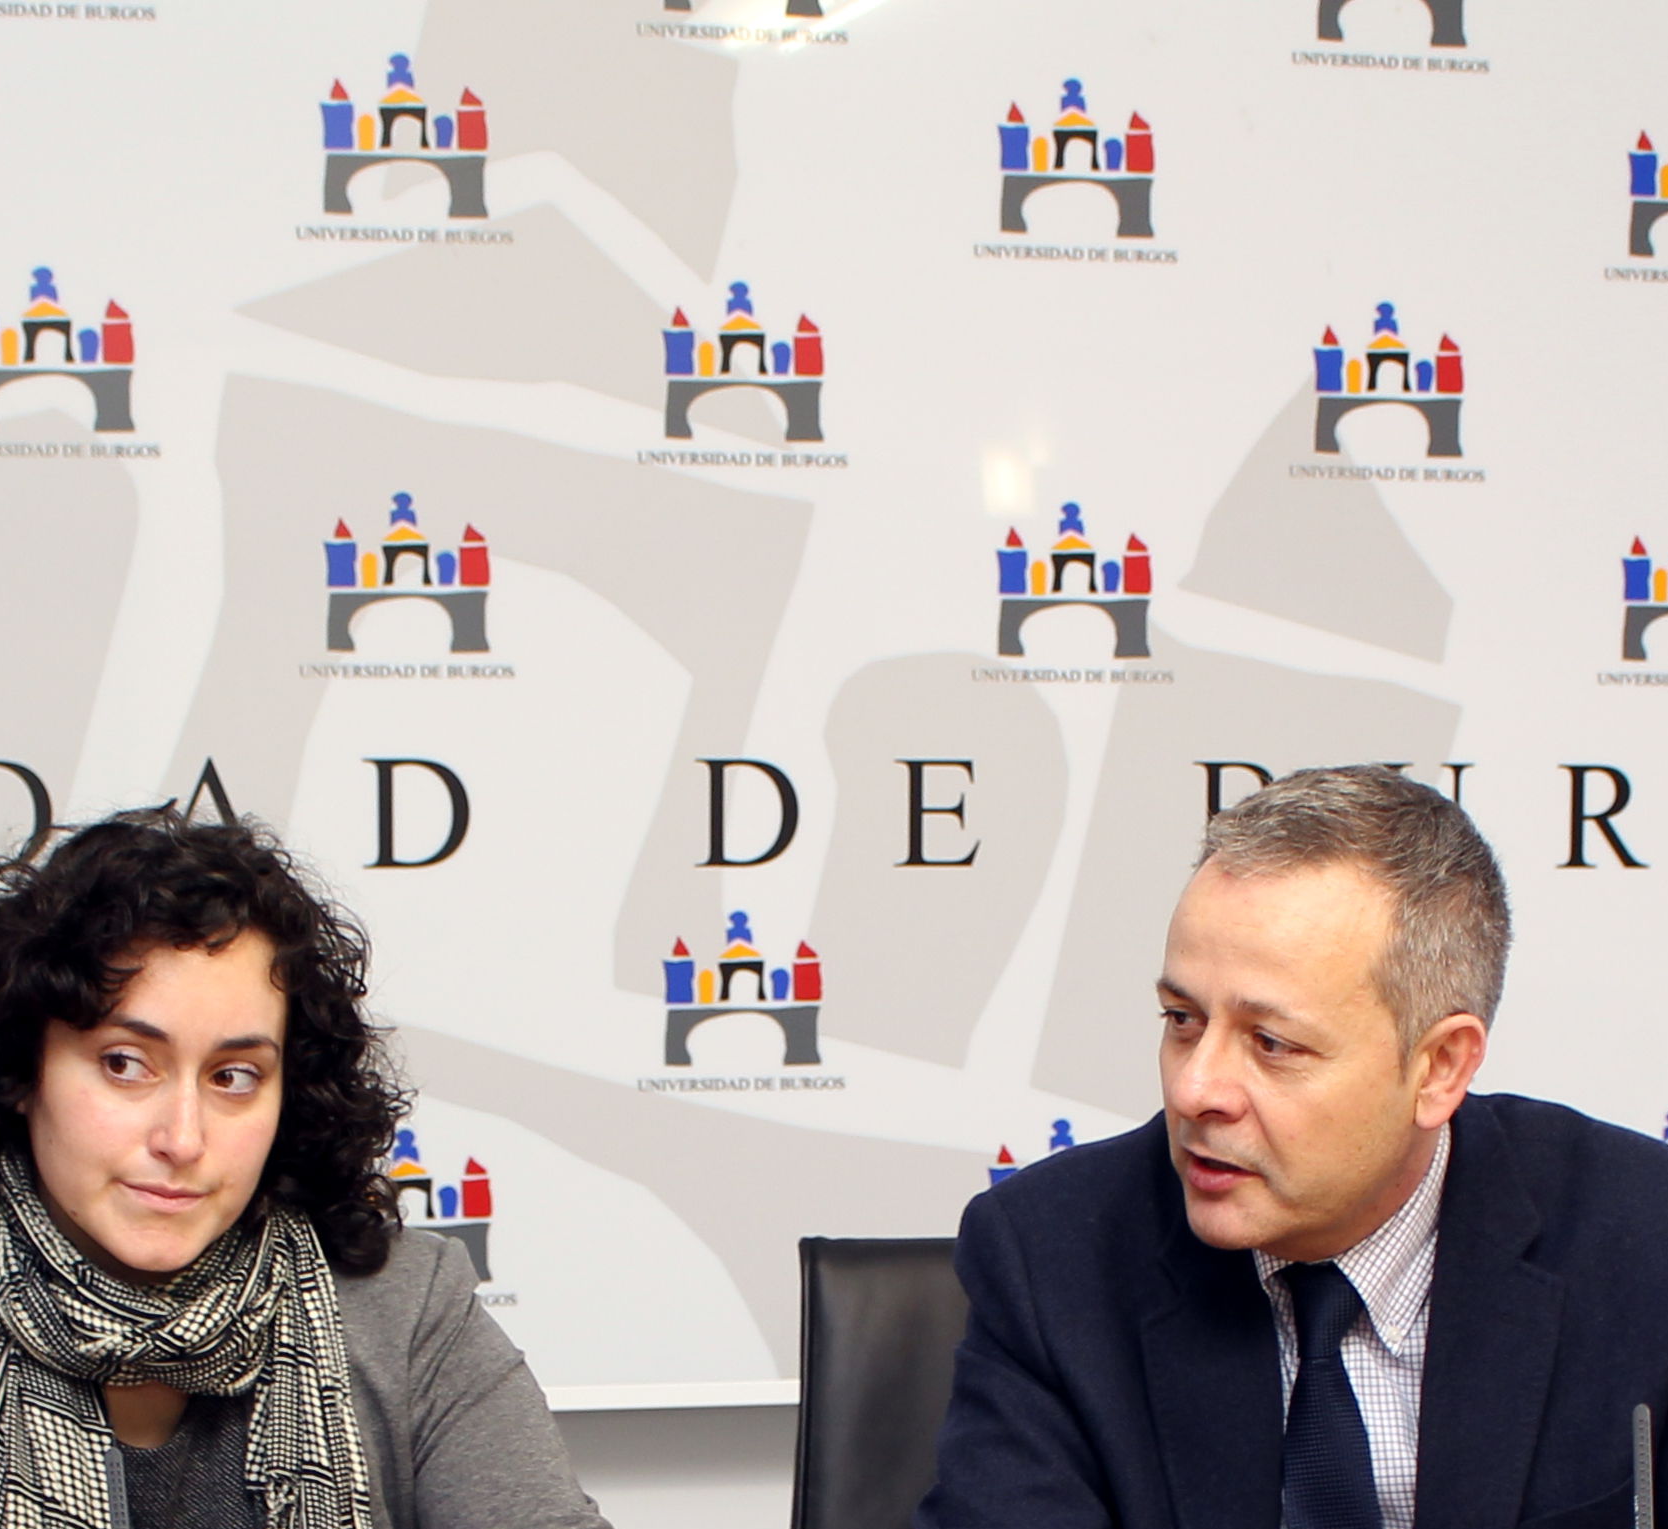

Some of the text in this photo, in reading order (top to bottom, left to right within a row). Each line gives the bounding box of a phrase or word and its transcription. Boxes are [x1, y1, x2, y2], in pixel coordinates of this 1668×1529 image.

[56, 4, 79, 19] DE
[84, 5, 157, 20] BURGOS
[1290, 53, 1491, 72] UNIVERSIDAD DE BURGOS
[294, 227, 515, 244] UNIVERSIDAD DE BURGOS
[972, 245, 1179, 263] UNIVERSIDAD DE BURGOS
[636, 452, 849, 468] UNIVERSIDAD DE BURGOS
[298, 664, 516, 679] UNIVERSIDAD DE BURGOS
[970, 669, 1175, 683] UNIVERSIDAD DE BURGOS
[695, 757, 983, 868] DE
[637, 1077, 847, 1091] UNIVERSIDAD DE BURGOS
